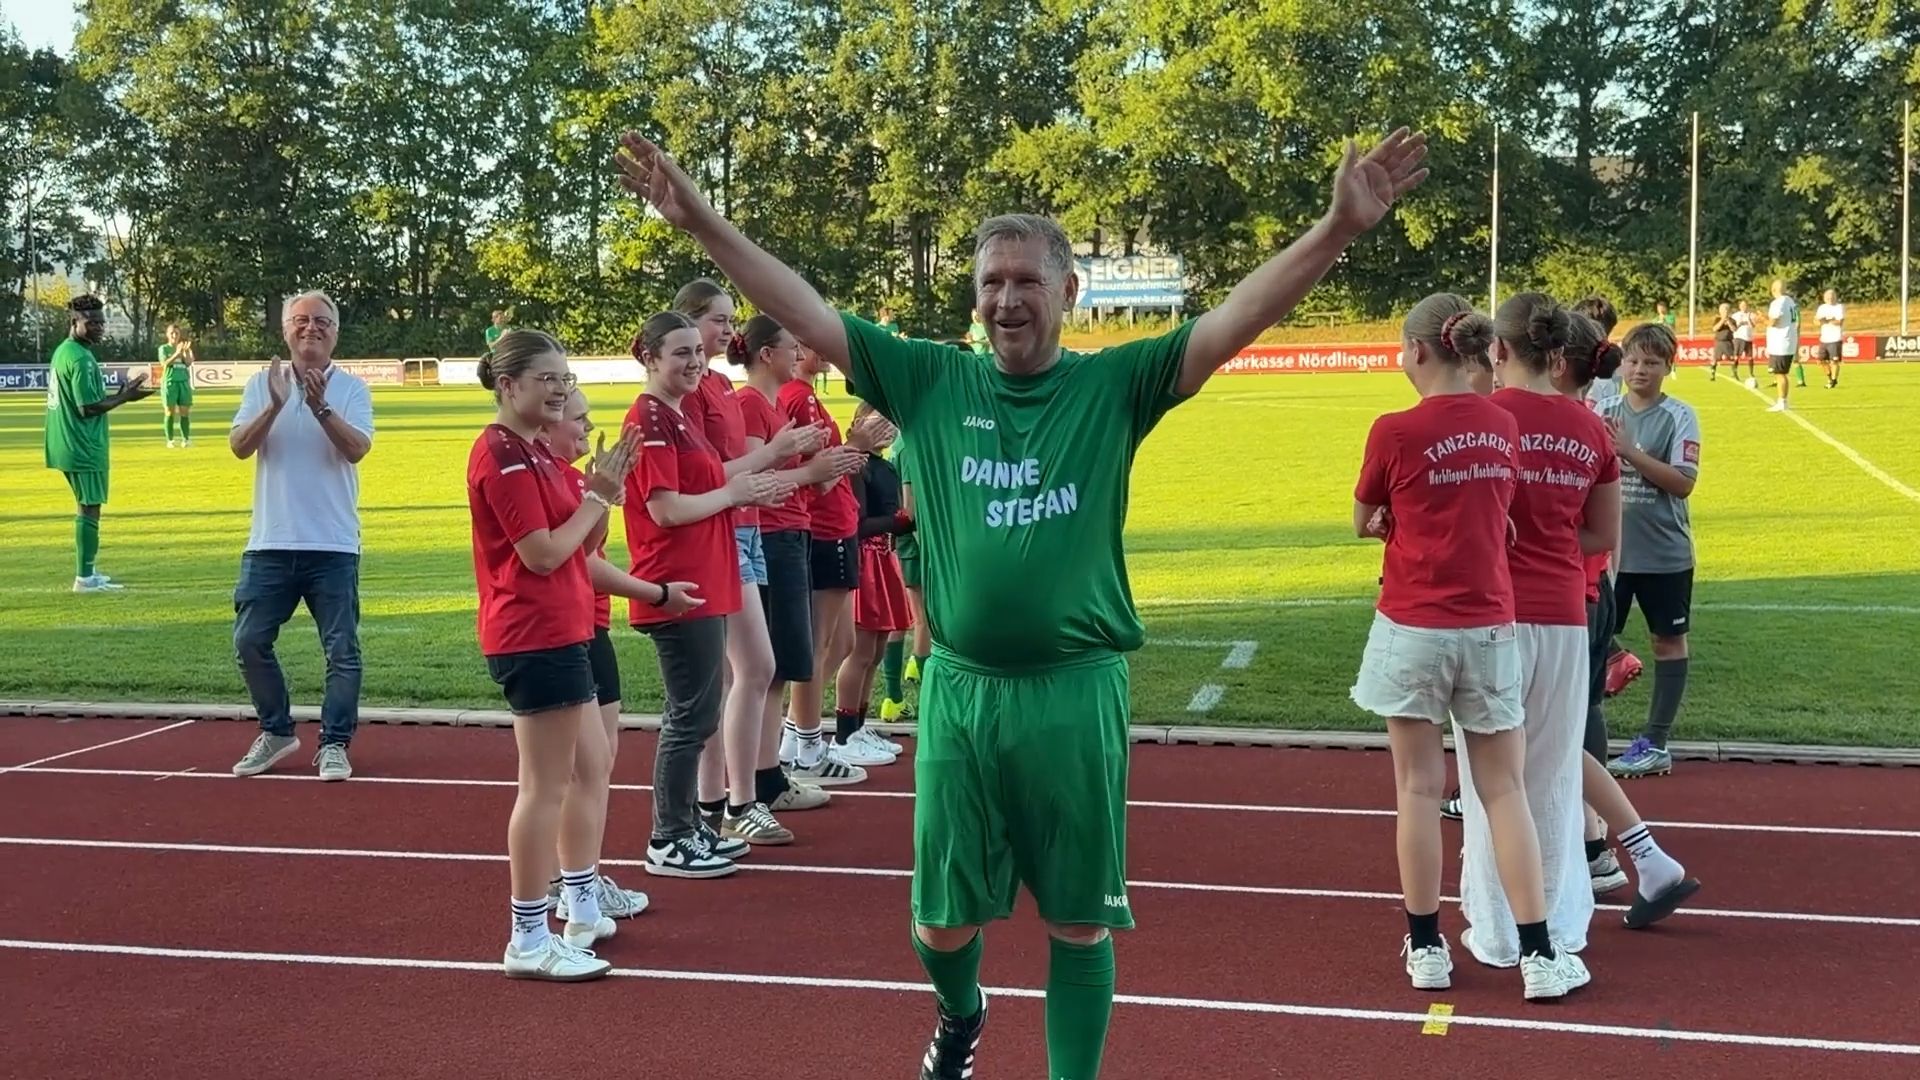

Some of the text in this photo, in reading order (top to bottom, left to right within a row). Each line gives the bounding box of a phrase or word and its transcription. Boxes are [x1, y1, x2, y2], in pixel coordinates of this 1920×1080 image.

[1091, 258, 1180, 280] EIGNER
[1221, 352, 1388, 372] parkasse Nördlingen
[963, 415, 996, 430] JAKO
[1423, 431, 1514, 463] TANZGARDE
[1519, 433, 1599, 468] NZGARDE
[961, 455, 1040, 490] DANKE
[985, 482, 1078, 528] STEFAN
